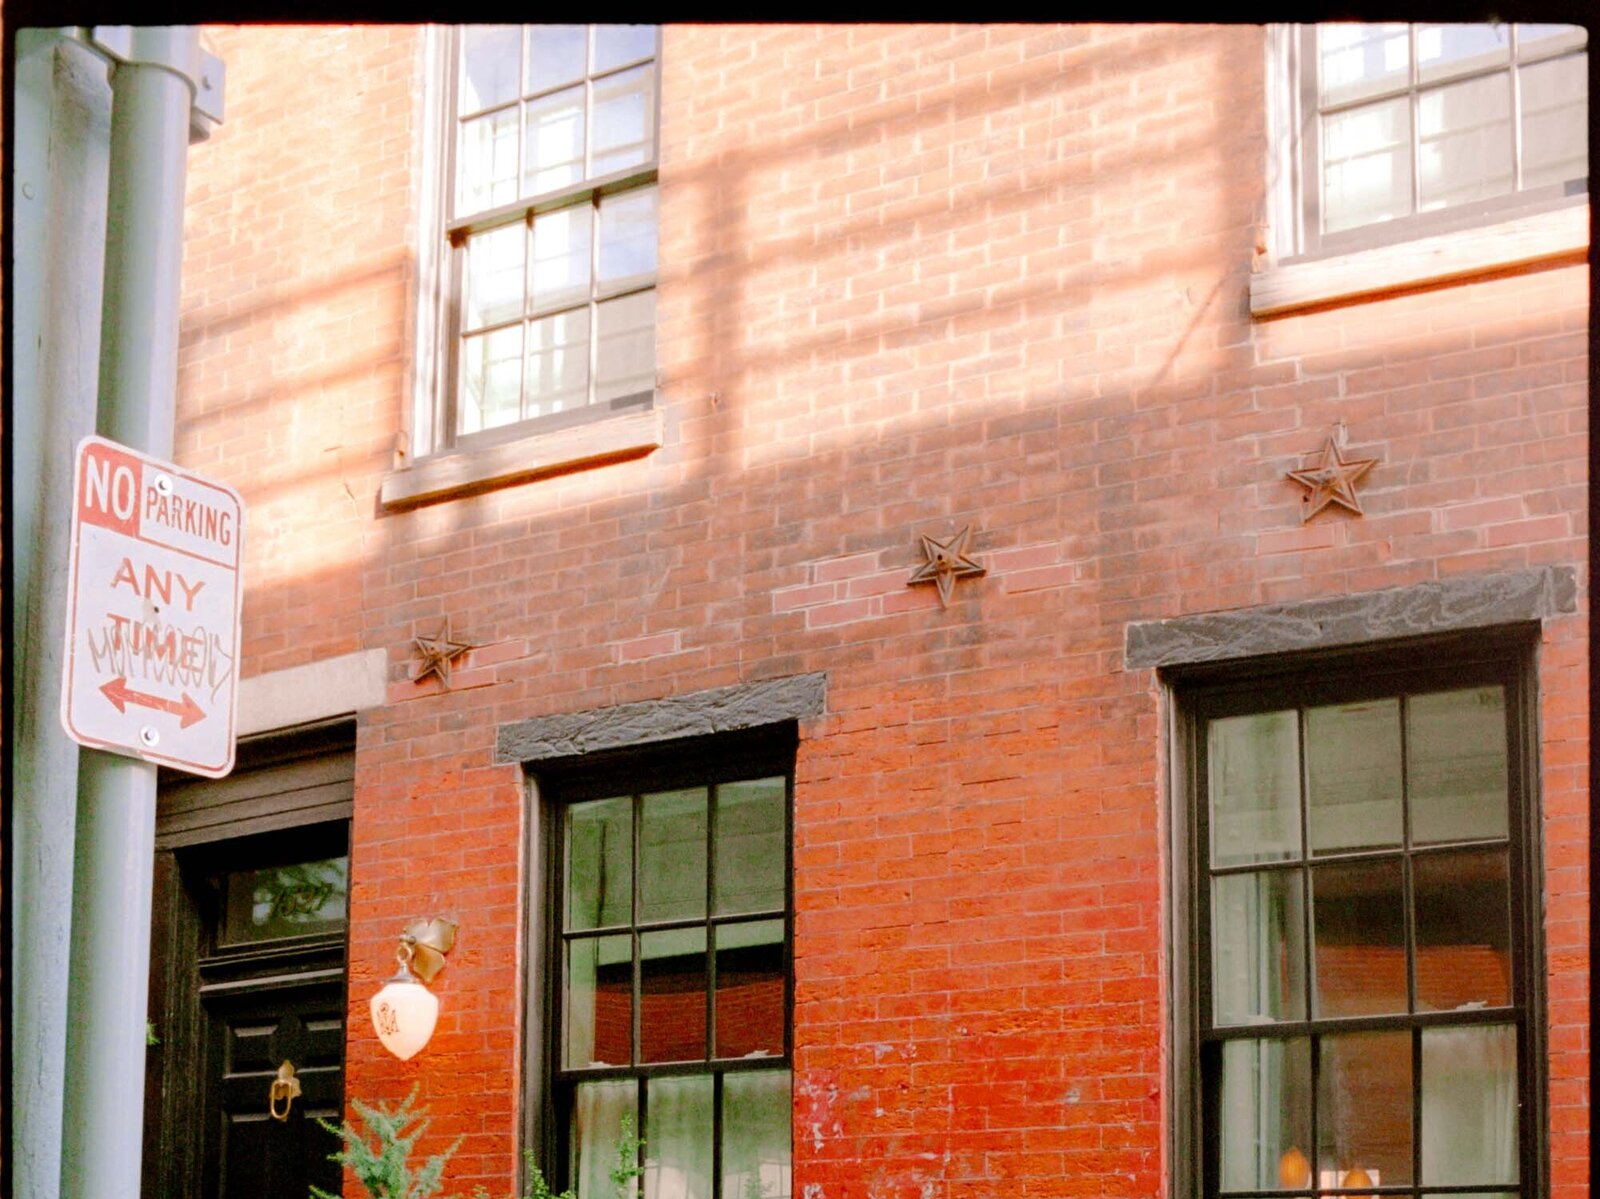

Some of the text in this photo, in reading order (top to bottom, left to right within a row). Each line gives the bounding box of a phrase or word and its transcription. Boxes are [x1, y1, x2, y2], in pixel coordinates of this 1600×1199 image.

[85, 454, 231, 546] NO PARKING
[110, 557, 206, 612] ANY
[106, 613, 204, 673] TIME
